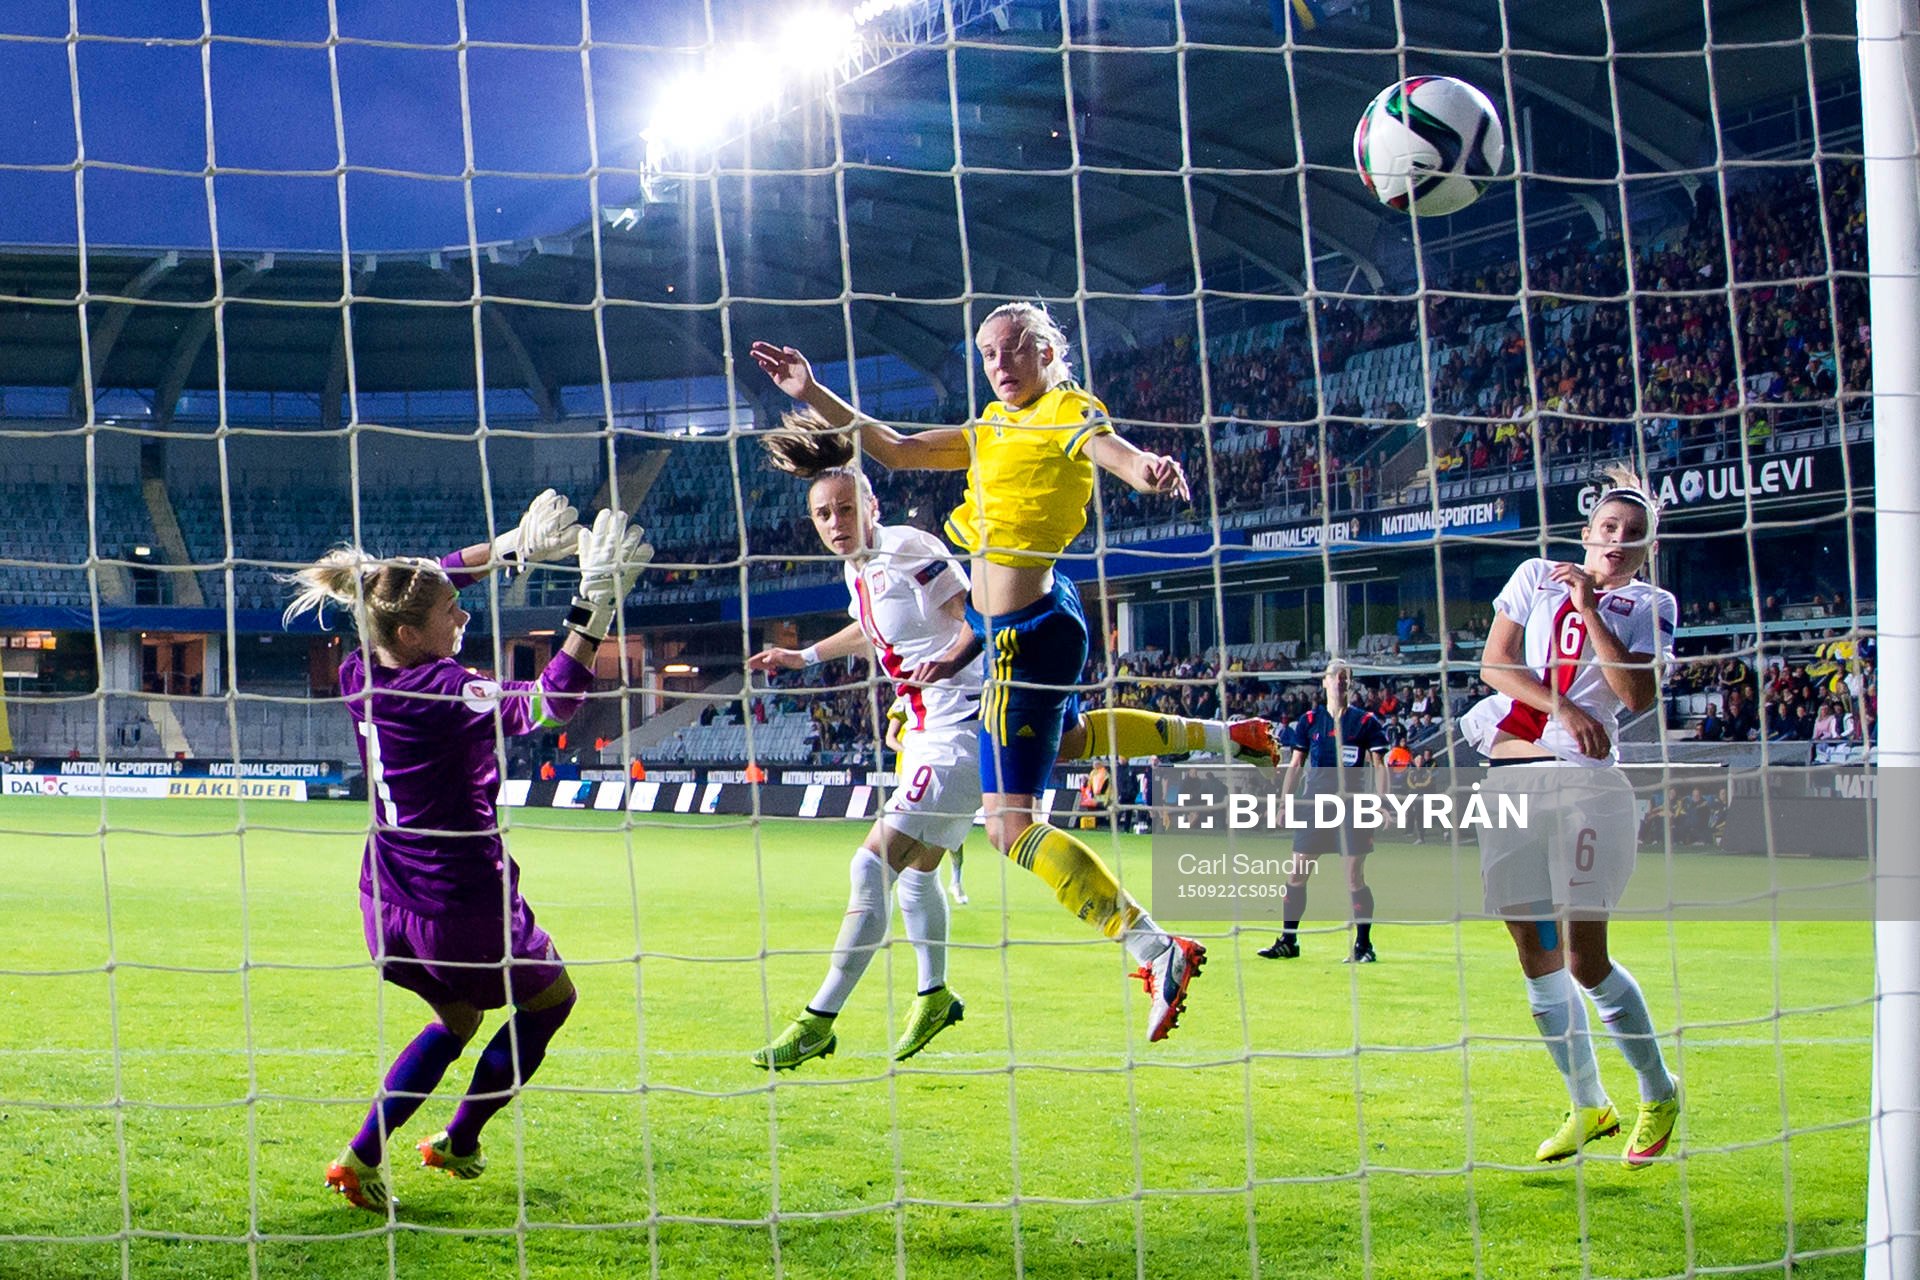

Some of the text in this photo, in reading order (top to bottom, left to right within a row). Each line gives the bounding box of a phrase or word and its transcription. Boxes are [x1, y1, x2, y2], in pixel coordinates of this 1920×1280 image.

[1708, 456, 1812, 499] ULLEVI
[1252, 521, 1350, 552] NATIONALSPOTEN
[1560, 611, 1583, 655] 6
[906, 765, 932, 802] 9
[1575, 828, 1597, 872] 6
